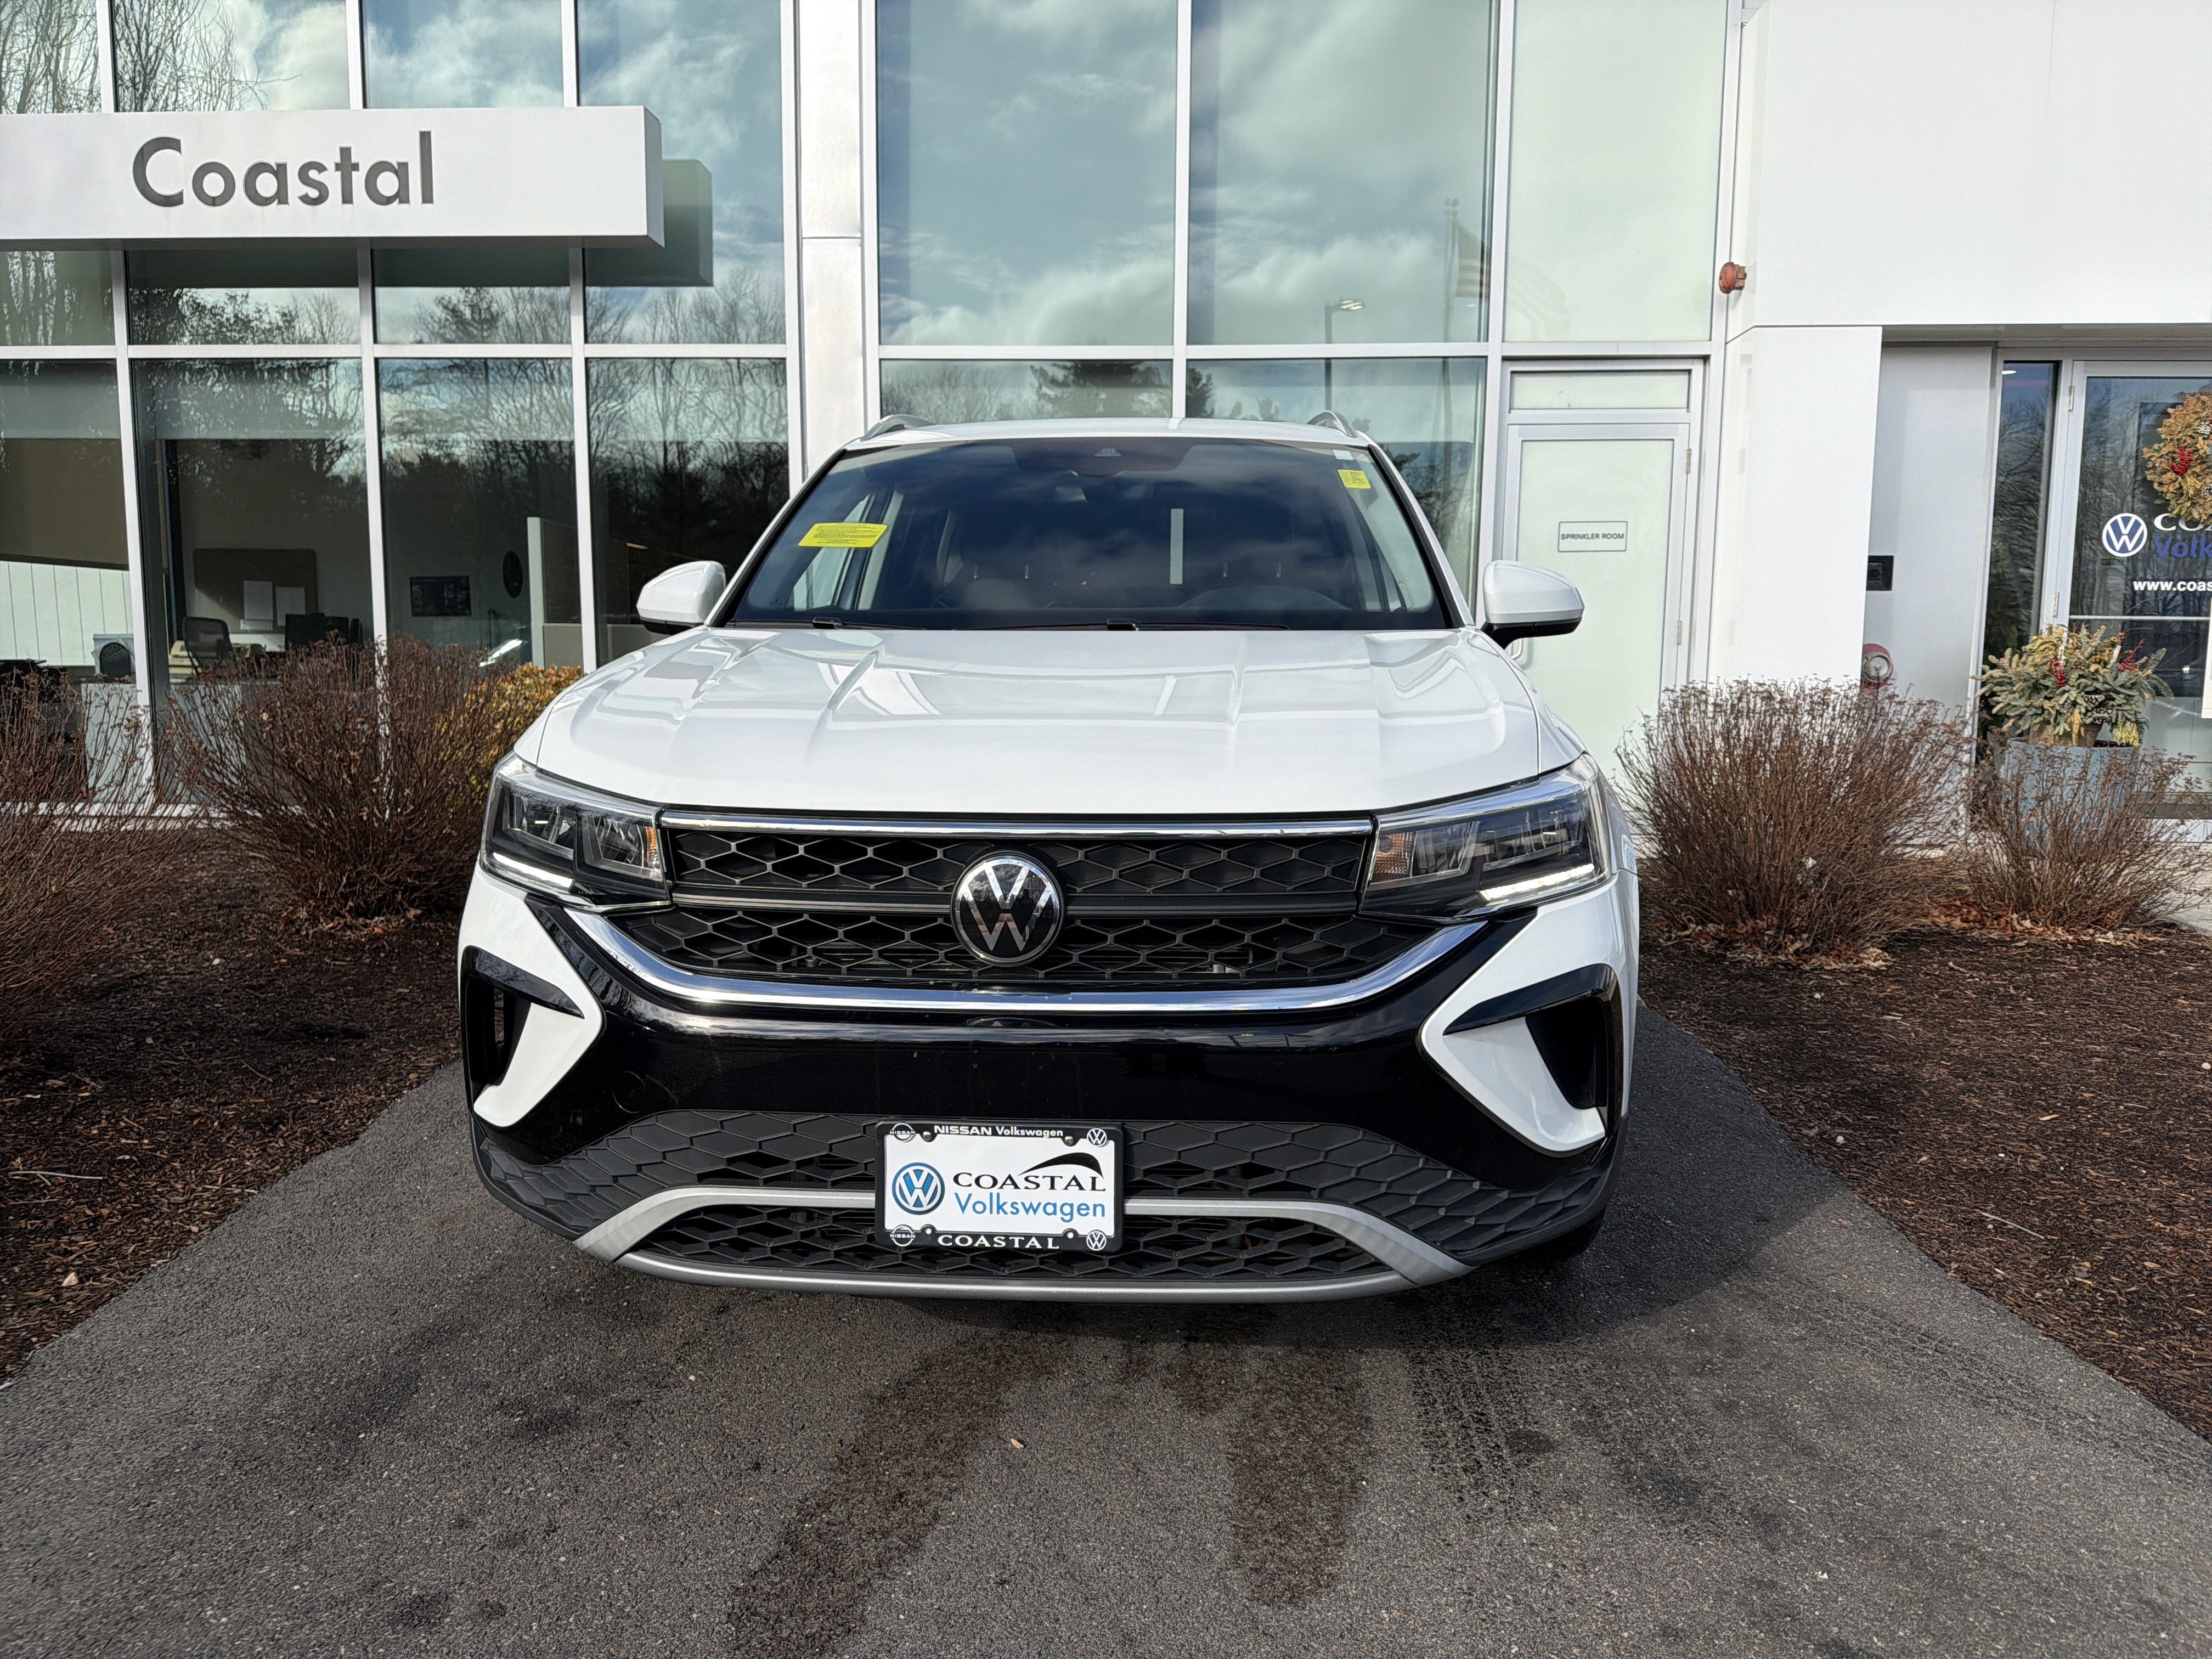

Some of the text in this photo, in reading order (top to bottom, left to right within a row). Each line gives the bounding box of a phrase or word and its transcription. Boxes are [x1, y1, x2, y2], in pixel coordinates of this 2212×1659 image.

[132, 130, 435, 207] Coastal
[2154, 513, 2212, 531] CO
[934, 1125, 1063, 1139] NISSAN Volkswagen
[953, 1172, 1106, 1192] COASTAL
[954, 1192, 1105, 1222] Volkswagen
[938, 1235, 1059, 1249] COASTAL
